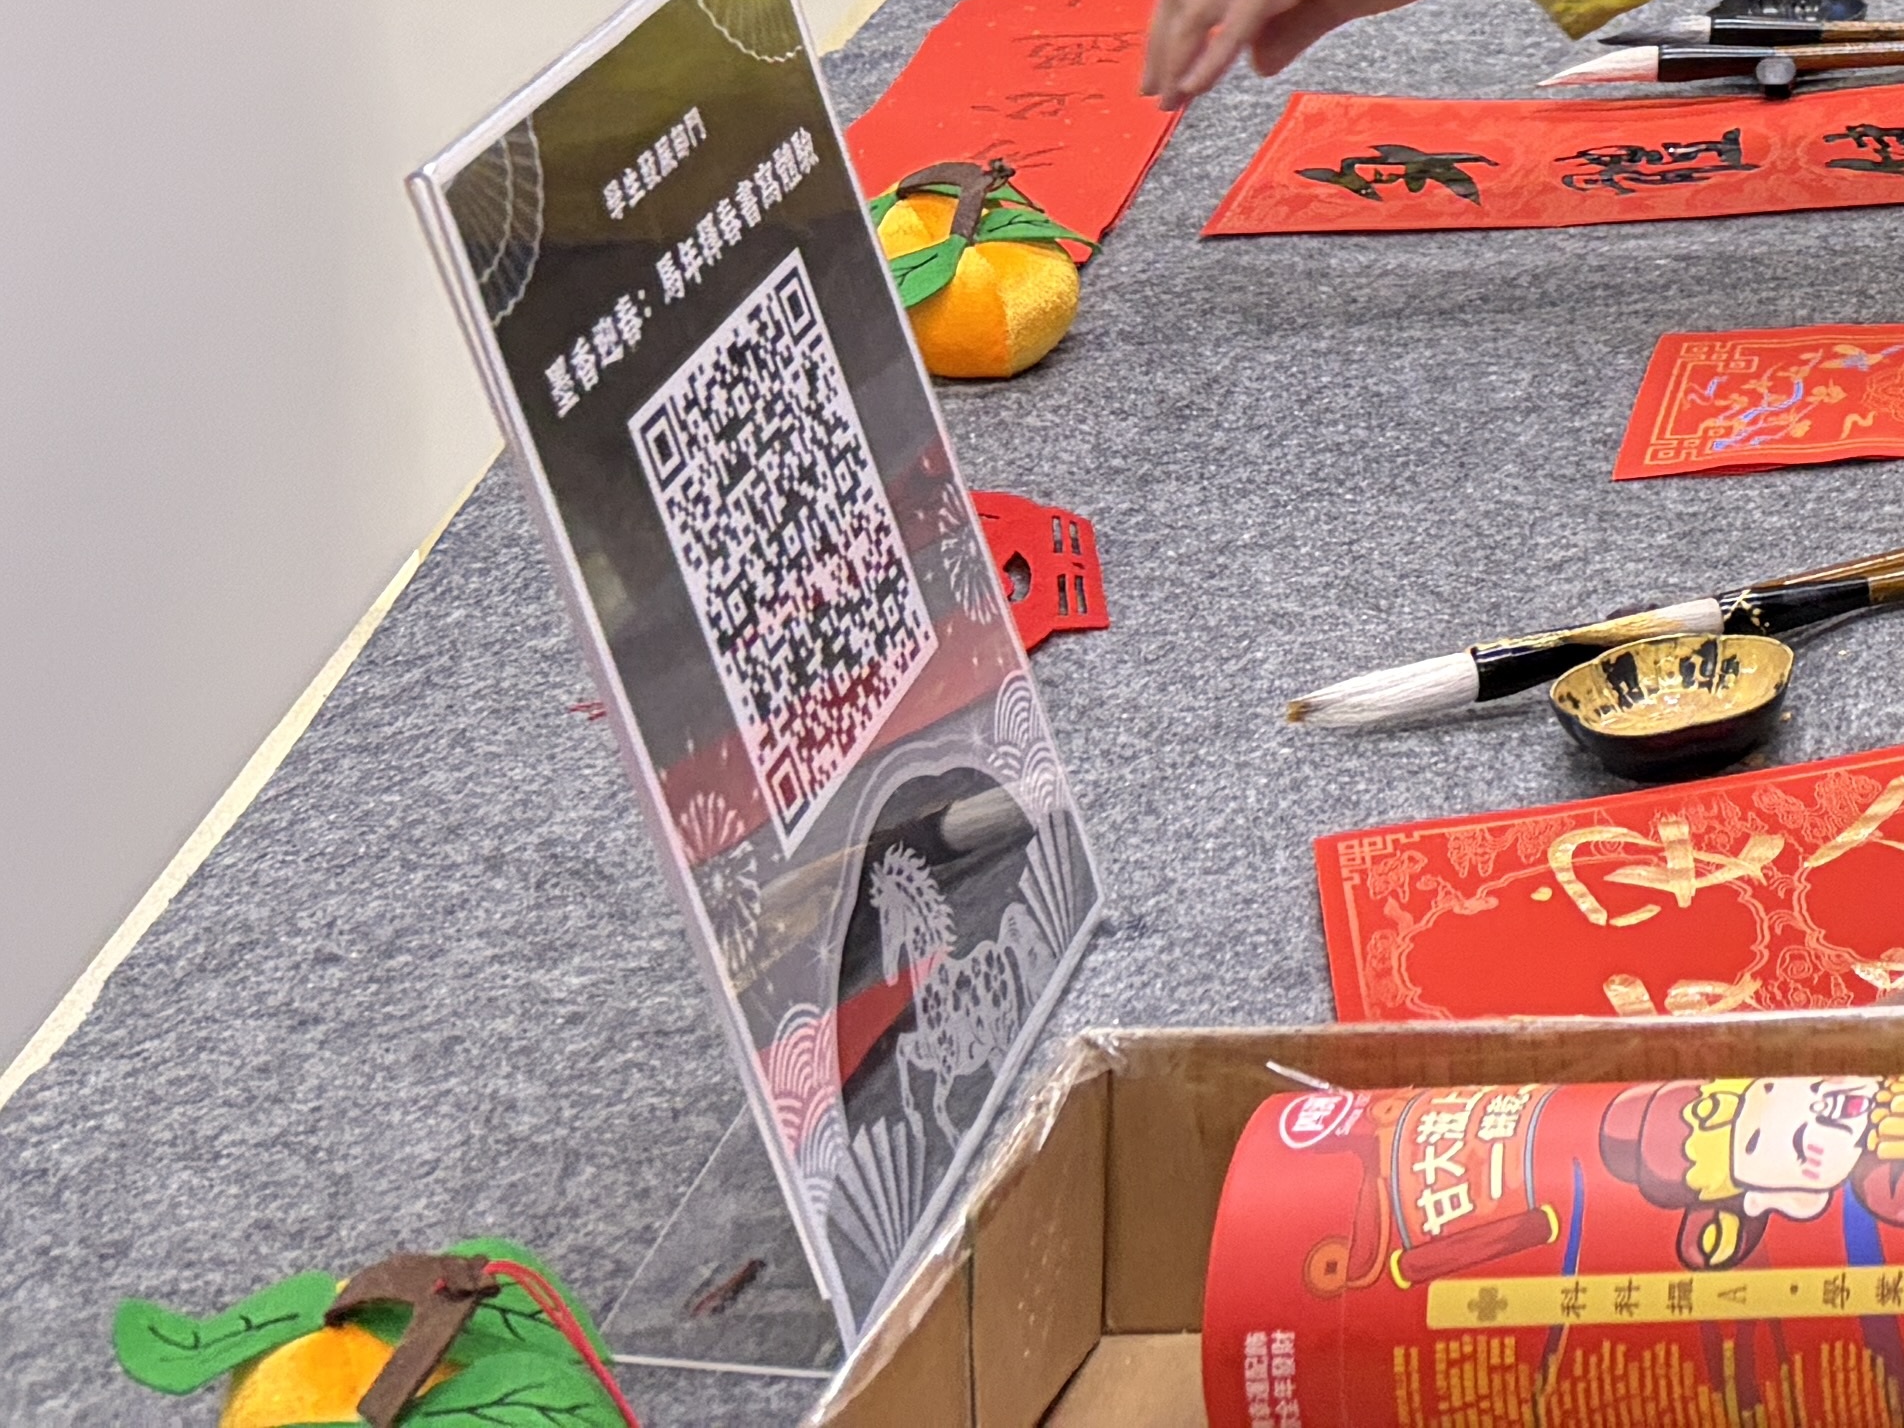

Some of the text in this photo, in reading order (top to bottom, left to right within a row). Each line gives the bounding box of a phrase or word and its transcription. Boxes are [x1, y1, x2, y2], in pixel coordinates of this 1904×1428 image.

[602, 105, 707, 221] 學生發展部門
